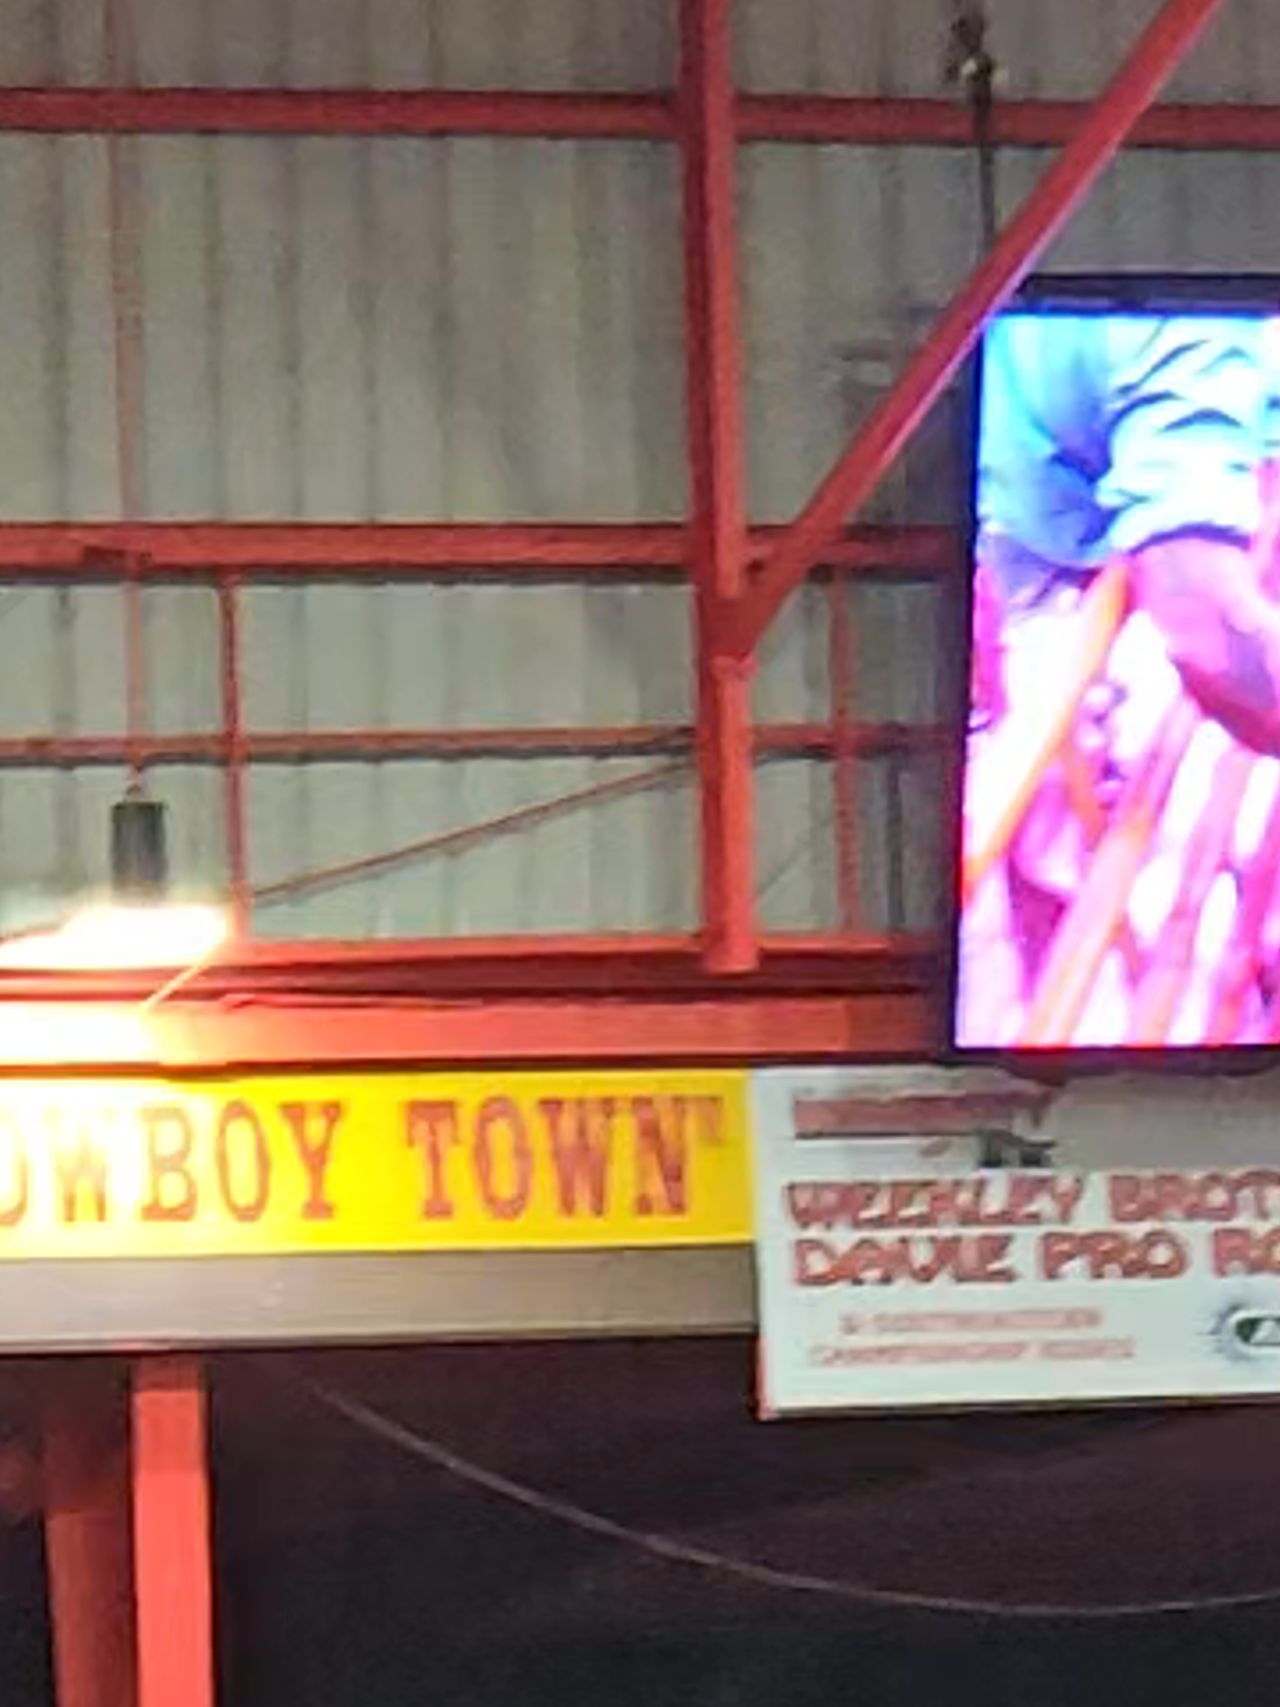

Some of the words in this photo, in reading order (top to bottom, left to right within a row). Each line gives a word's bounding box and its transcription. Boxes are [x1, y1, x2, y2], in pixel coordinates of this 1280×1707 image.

[786, 1175, 1085, 1230] WEEKLEY
[794, 1233, 1018, 1287] DAVIE
[1041, 1229, 1188, 1281] PRO
